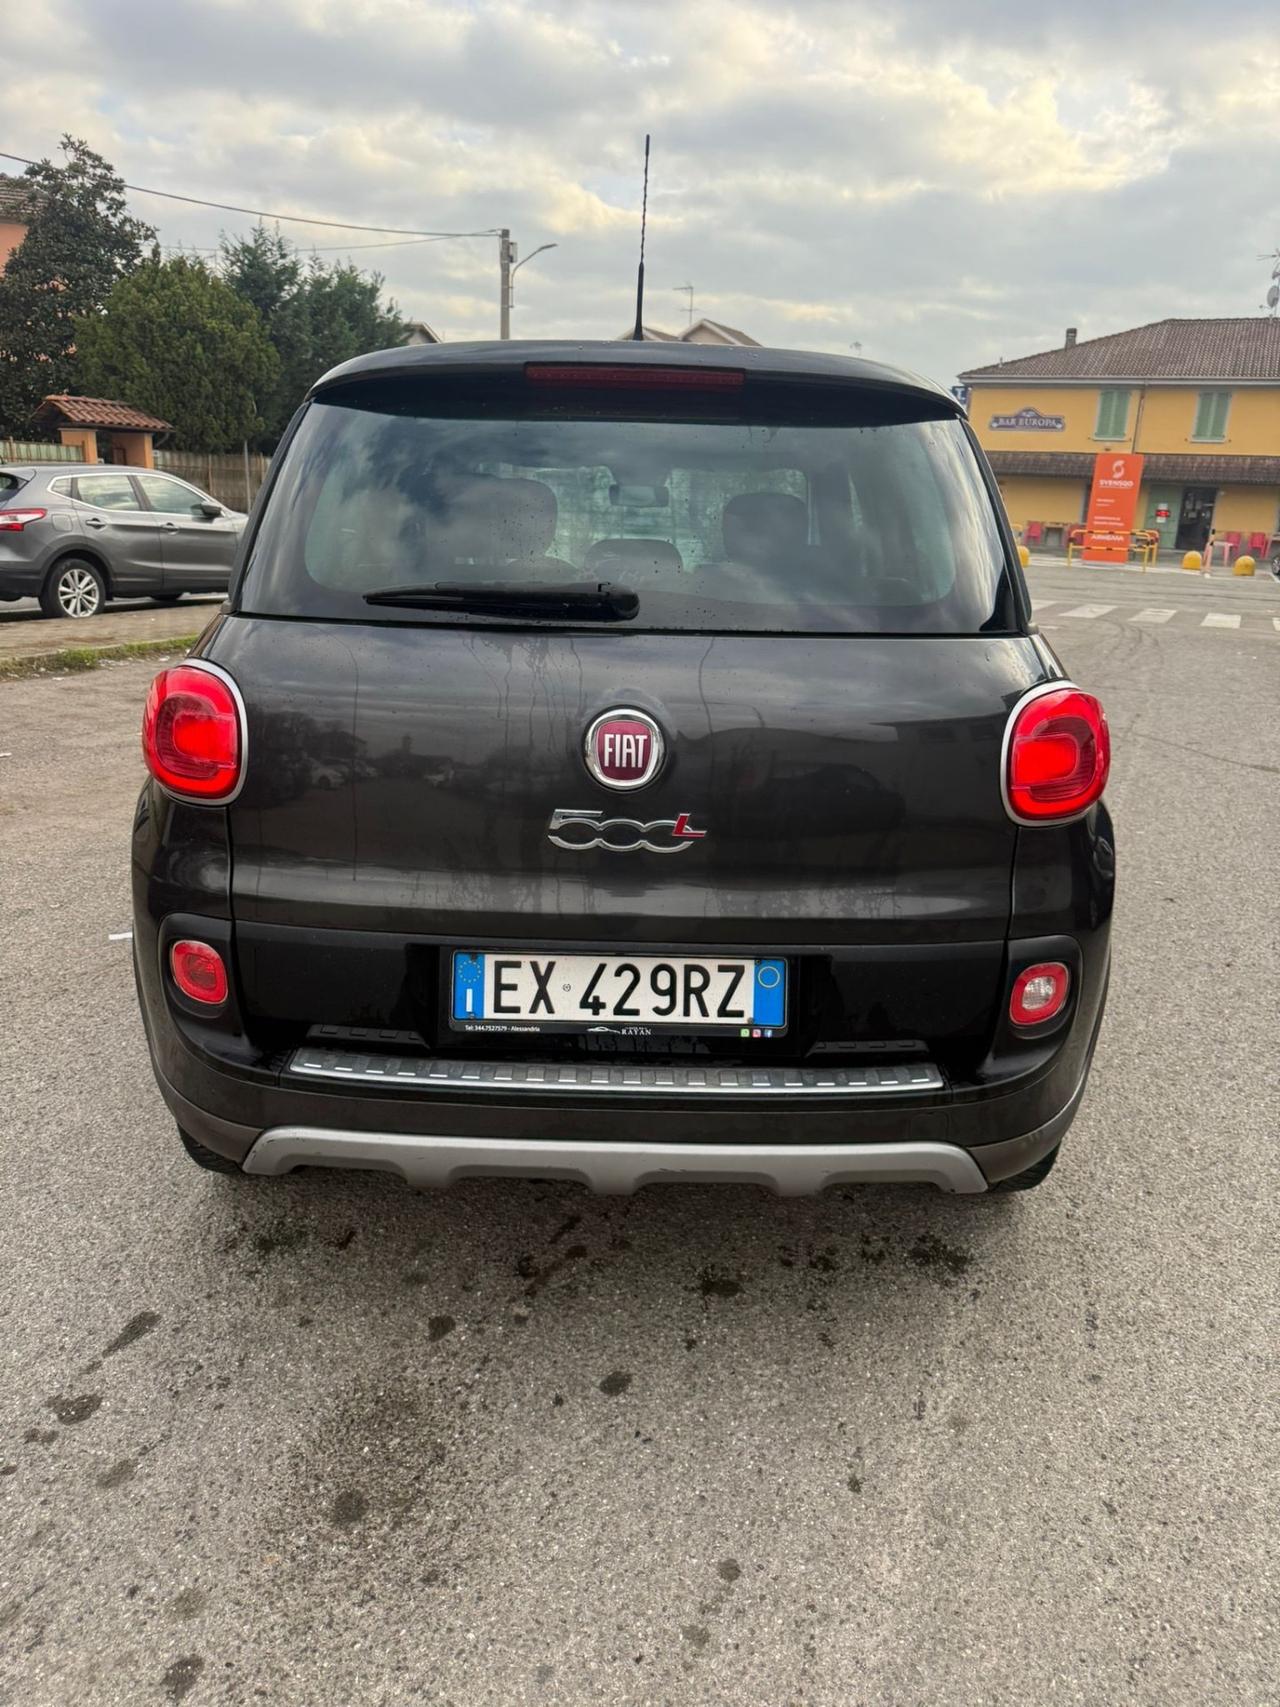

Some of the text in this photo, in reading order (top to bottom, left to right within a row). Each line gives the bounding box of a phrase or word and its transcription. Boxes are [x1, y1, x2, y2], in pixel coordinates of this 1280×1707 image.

[998, 417, 1057, 427] BAR EUROPA
[603, 733, 648, 769] FIAT
[547, 808, 708, 854] 500L
[492, 959, 746, 1018] EX 429RZ
